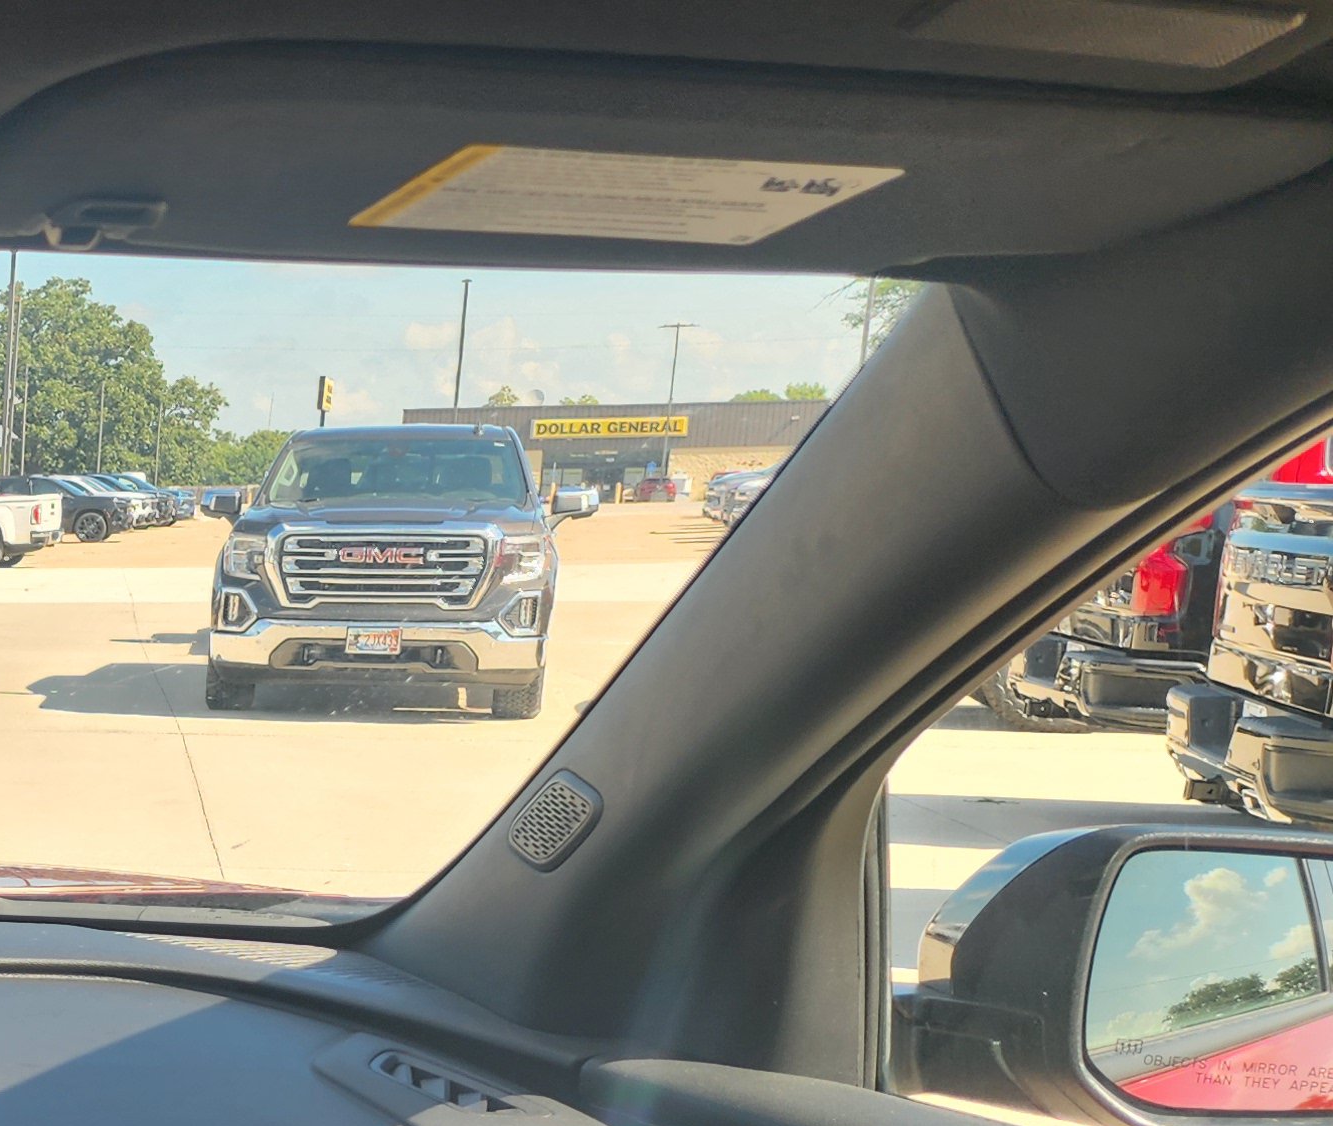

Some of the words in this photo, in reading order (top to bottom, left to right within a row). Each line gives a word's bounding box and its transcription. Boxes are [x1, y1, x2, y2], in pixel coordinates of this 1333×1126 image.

[536, 422, 601, 435] DOLLAR
[607, 420, 682, 434] GENERAL
[338, 546, 425, 565] GMC
[1143, 1054, 1208, 1069] OBJECTS
[1218, 1060, 1232, 1072] IN
[1242, 1062, 1298, 1076] MIRROR
[1307, 1066, 1333, 1080] ARE
[1196, 1072, 1233, 1086] THAN
[1244, 1076, 1281, 1089] THEY
